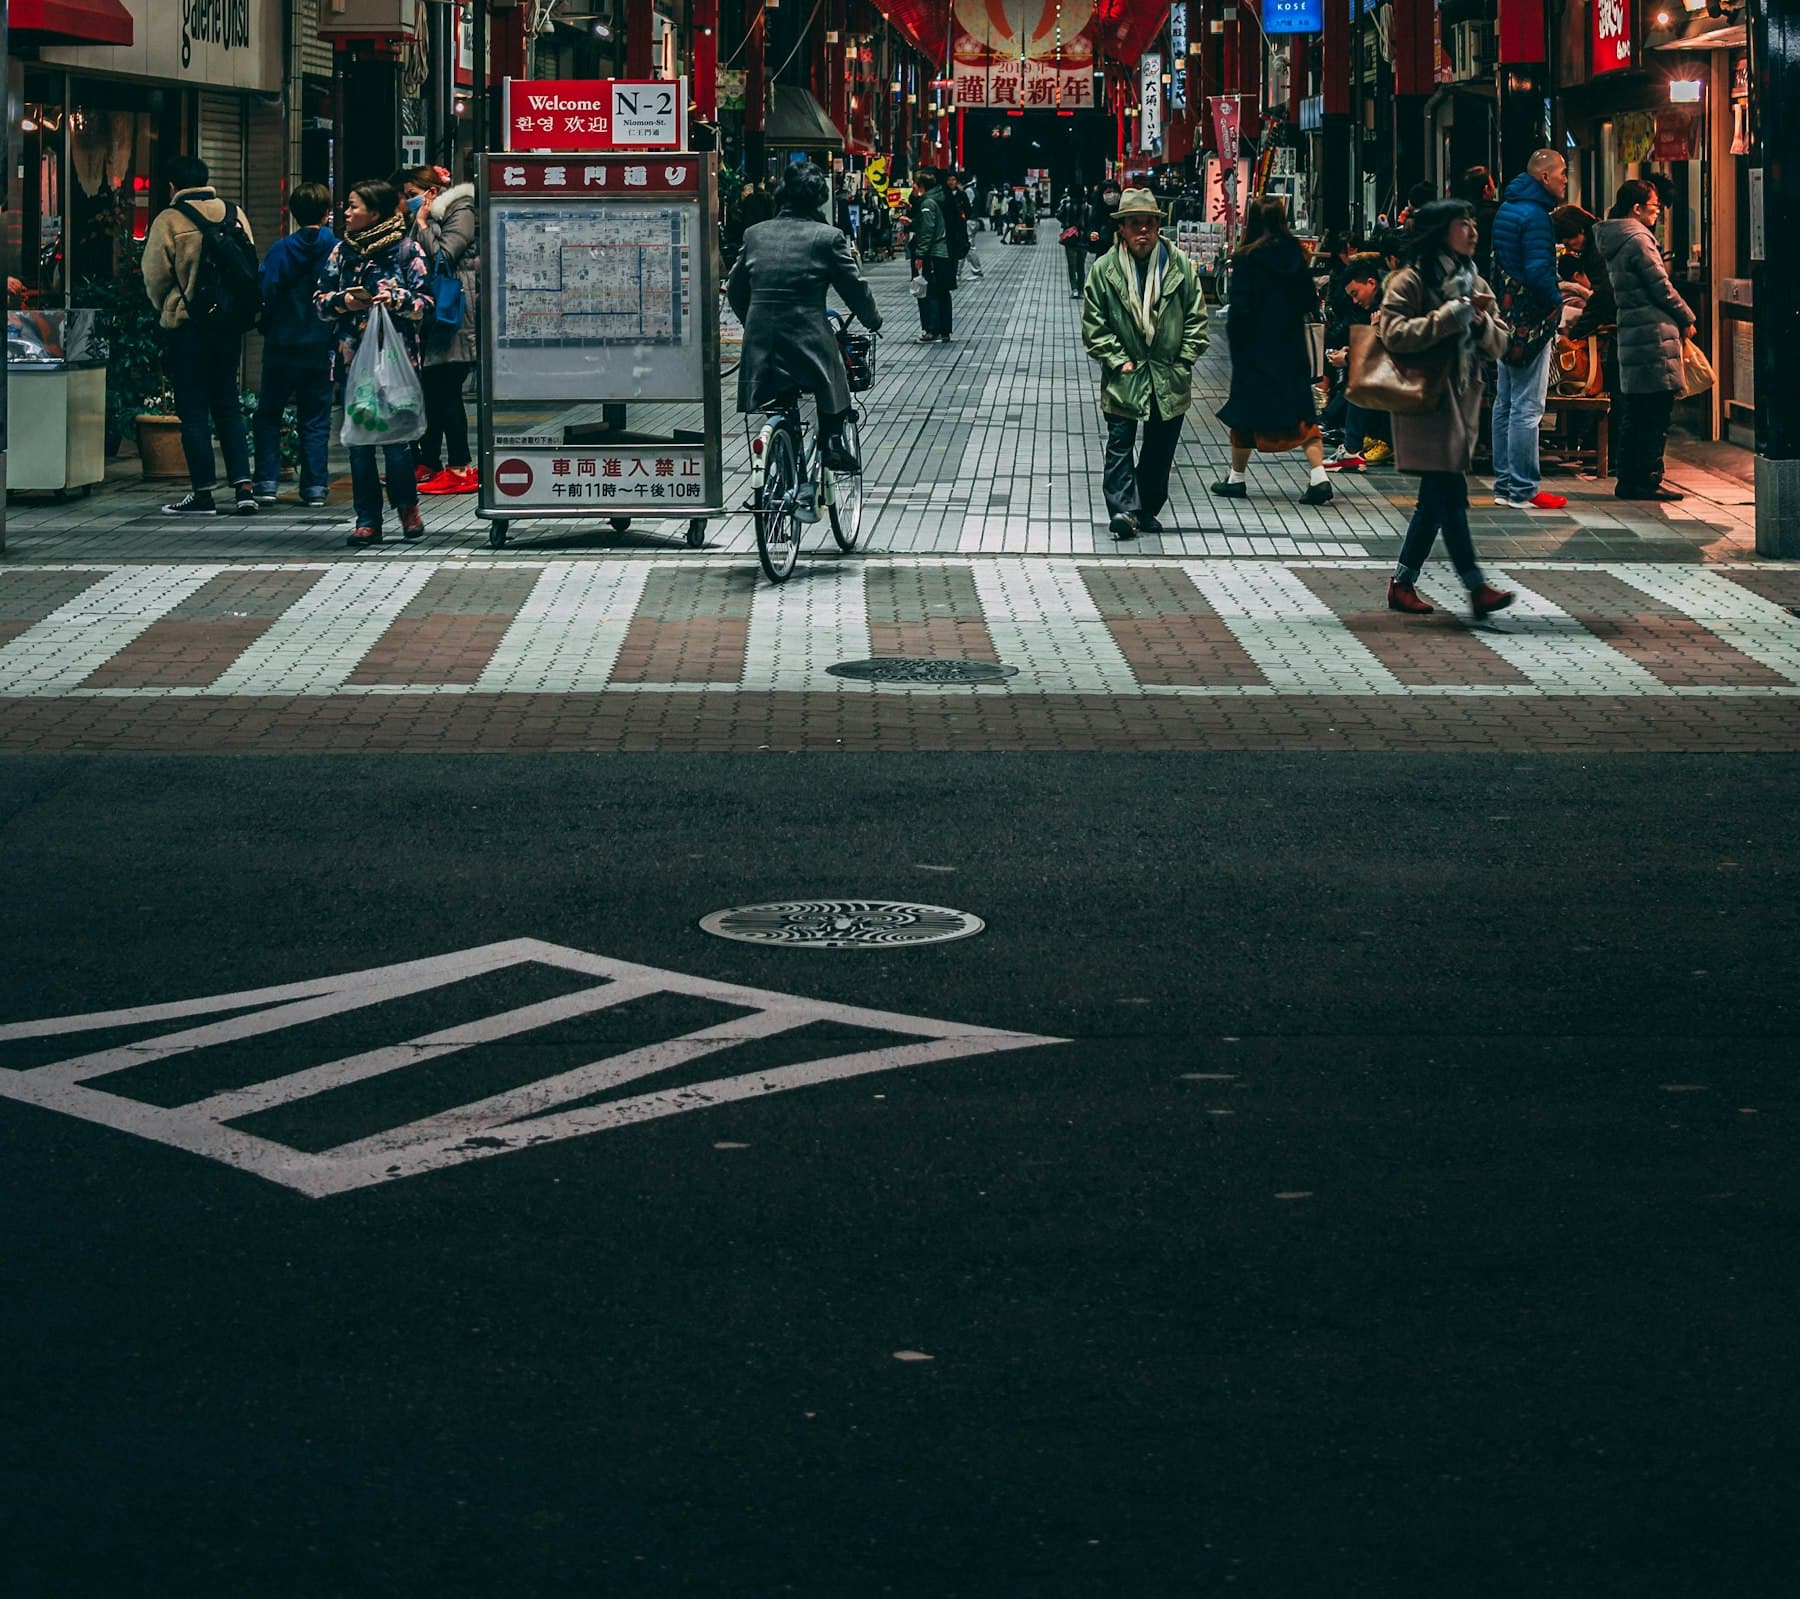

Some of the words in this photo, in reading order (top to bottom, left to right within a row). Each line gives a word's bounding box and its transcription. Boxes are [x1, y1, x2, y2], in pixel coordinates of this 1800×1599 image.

[1277, 1, 1306, 11] KOSÉ
[956, 75, 1091, 104] 謹賀新年
[528, 95, 600, 111] Welcome
[615, 92, 672, 115] N-2
[515, 116, 554, 132] 환영
[563, 116, 608, 133] 欢迎
[503, 166, 687, 186] 仁王門通り
[552, 458, 700, 477] 車両進入禁止
